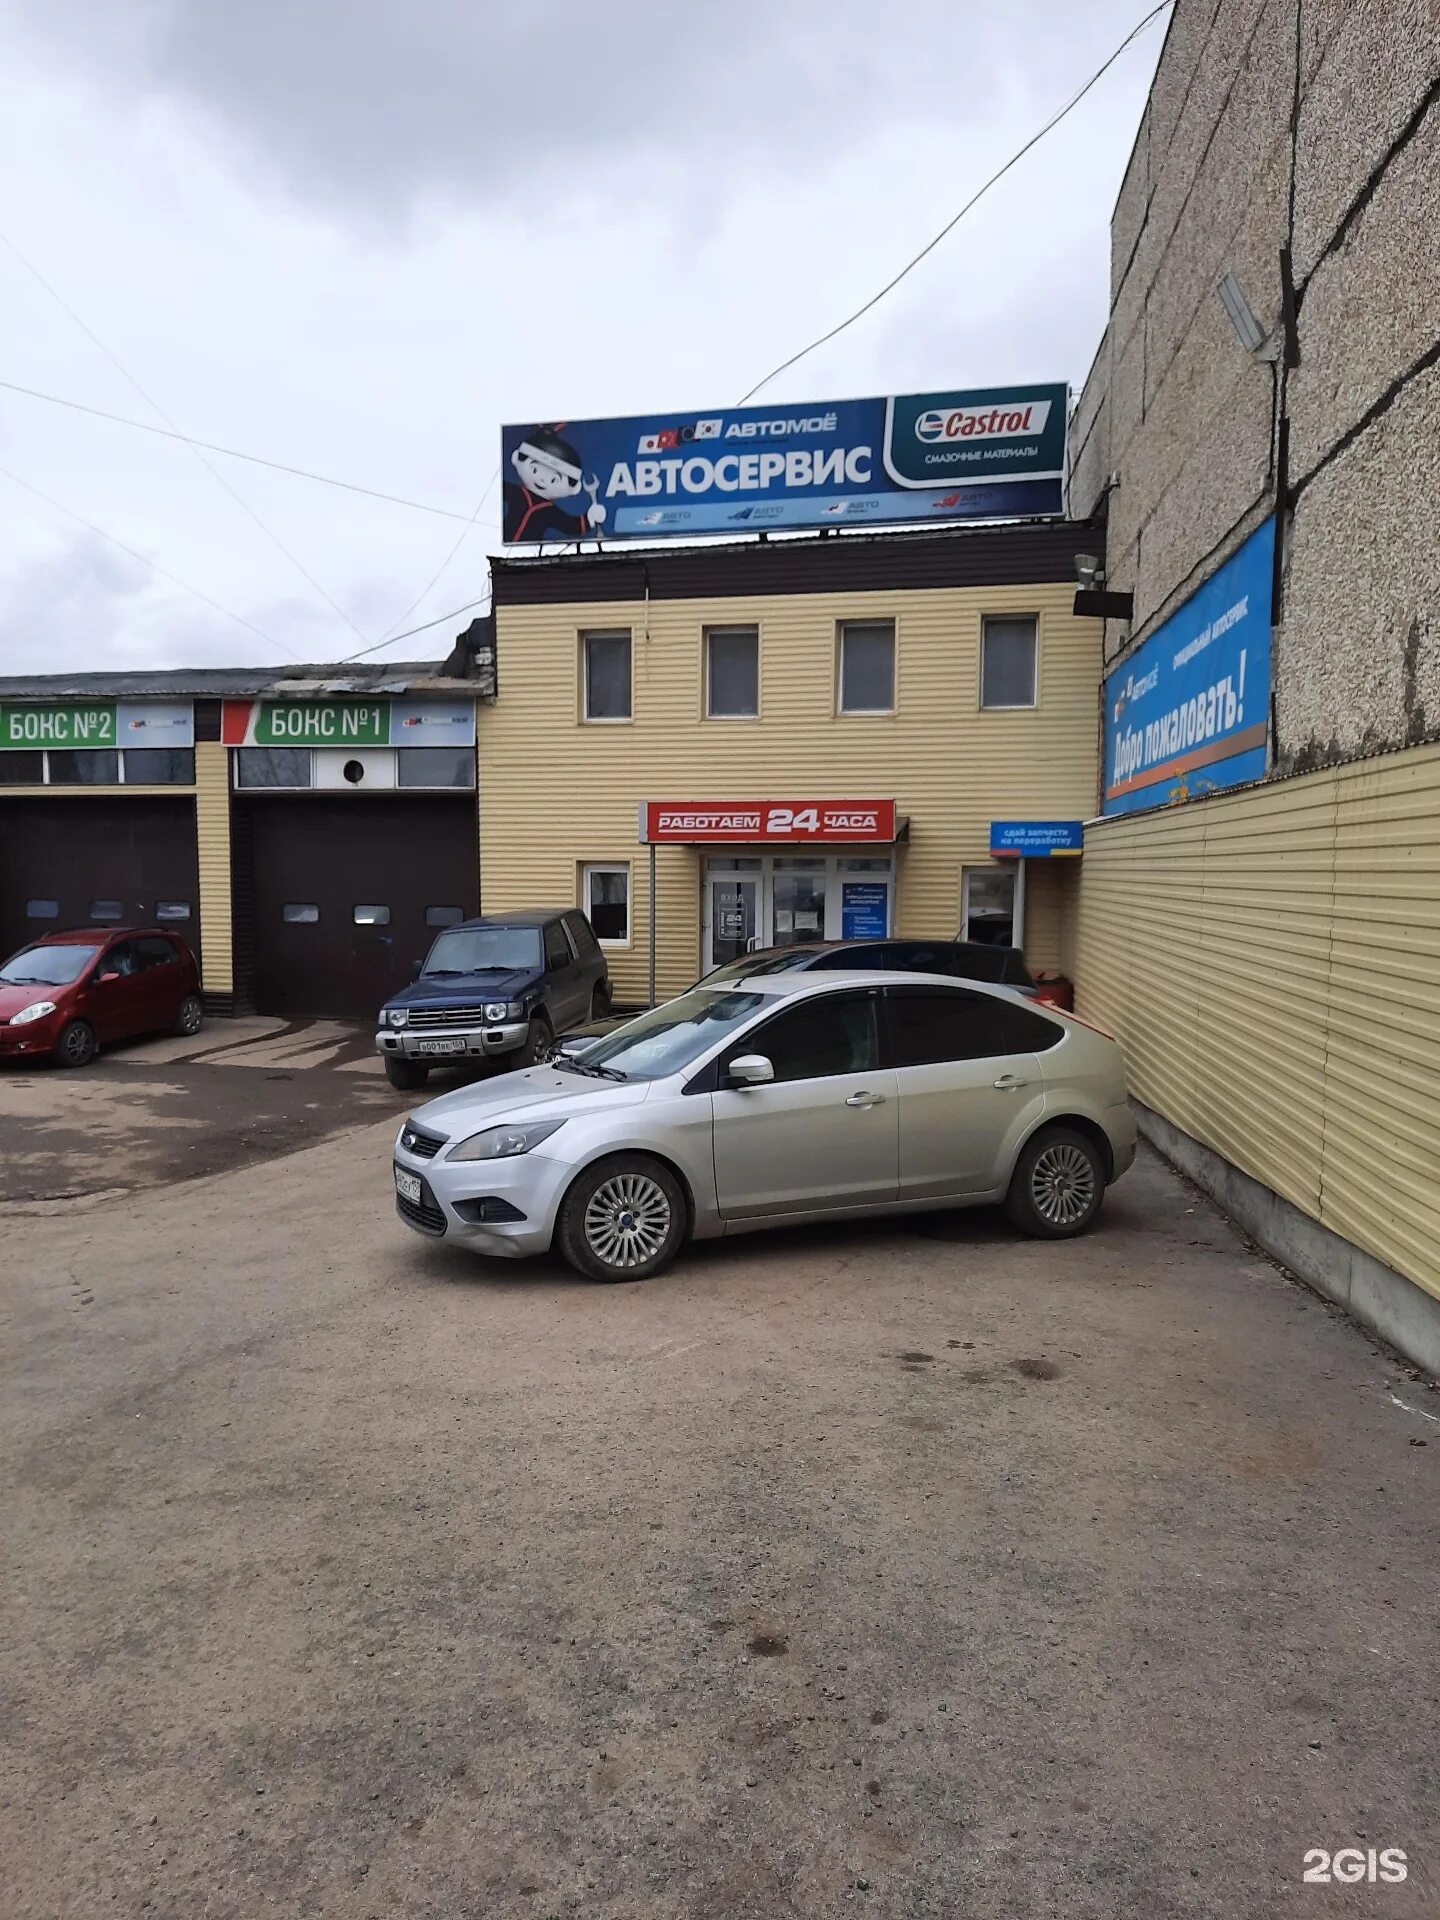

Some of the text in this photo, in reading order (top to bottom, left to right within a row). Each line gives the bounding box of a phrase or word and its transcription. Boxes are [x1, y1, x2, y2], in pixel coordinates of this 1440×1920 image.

[724, 412, 838, 439] АВТОМОЁ
[944, 405, 1034, 438] Castrol
[924, 446, 1038, 465] СМАЗОЧНЫЕ МАТЕРИАЛЫ
[605, 446, 872, 498] АВТОСЕРВИС
[9, 711, 112, 740] БОКС №2
[270, 707, 381, 736] БОКС №1
[1113, 649, 1248, 788] Добро пожаловать!
[658, 809, 878, 833] РАБОТАЕМ 24 ЧАСА
[1027, 829, 1069, 837] запчасти
[1013, 836, 1072, 846] переработку
